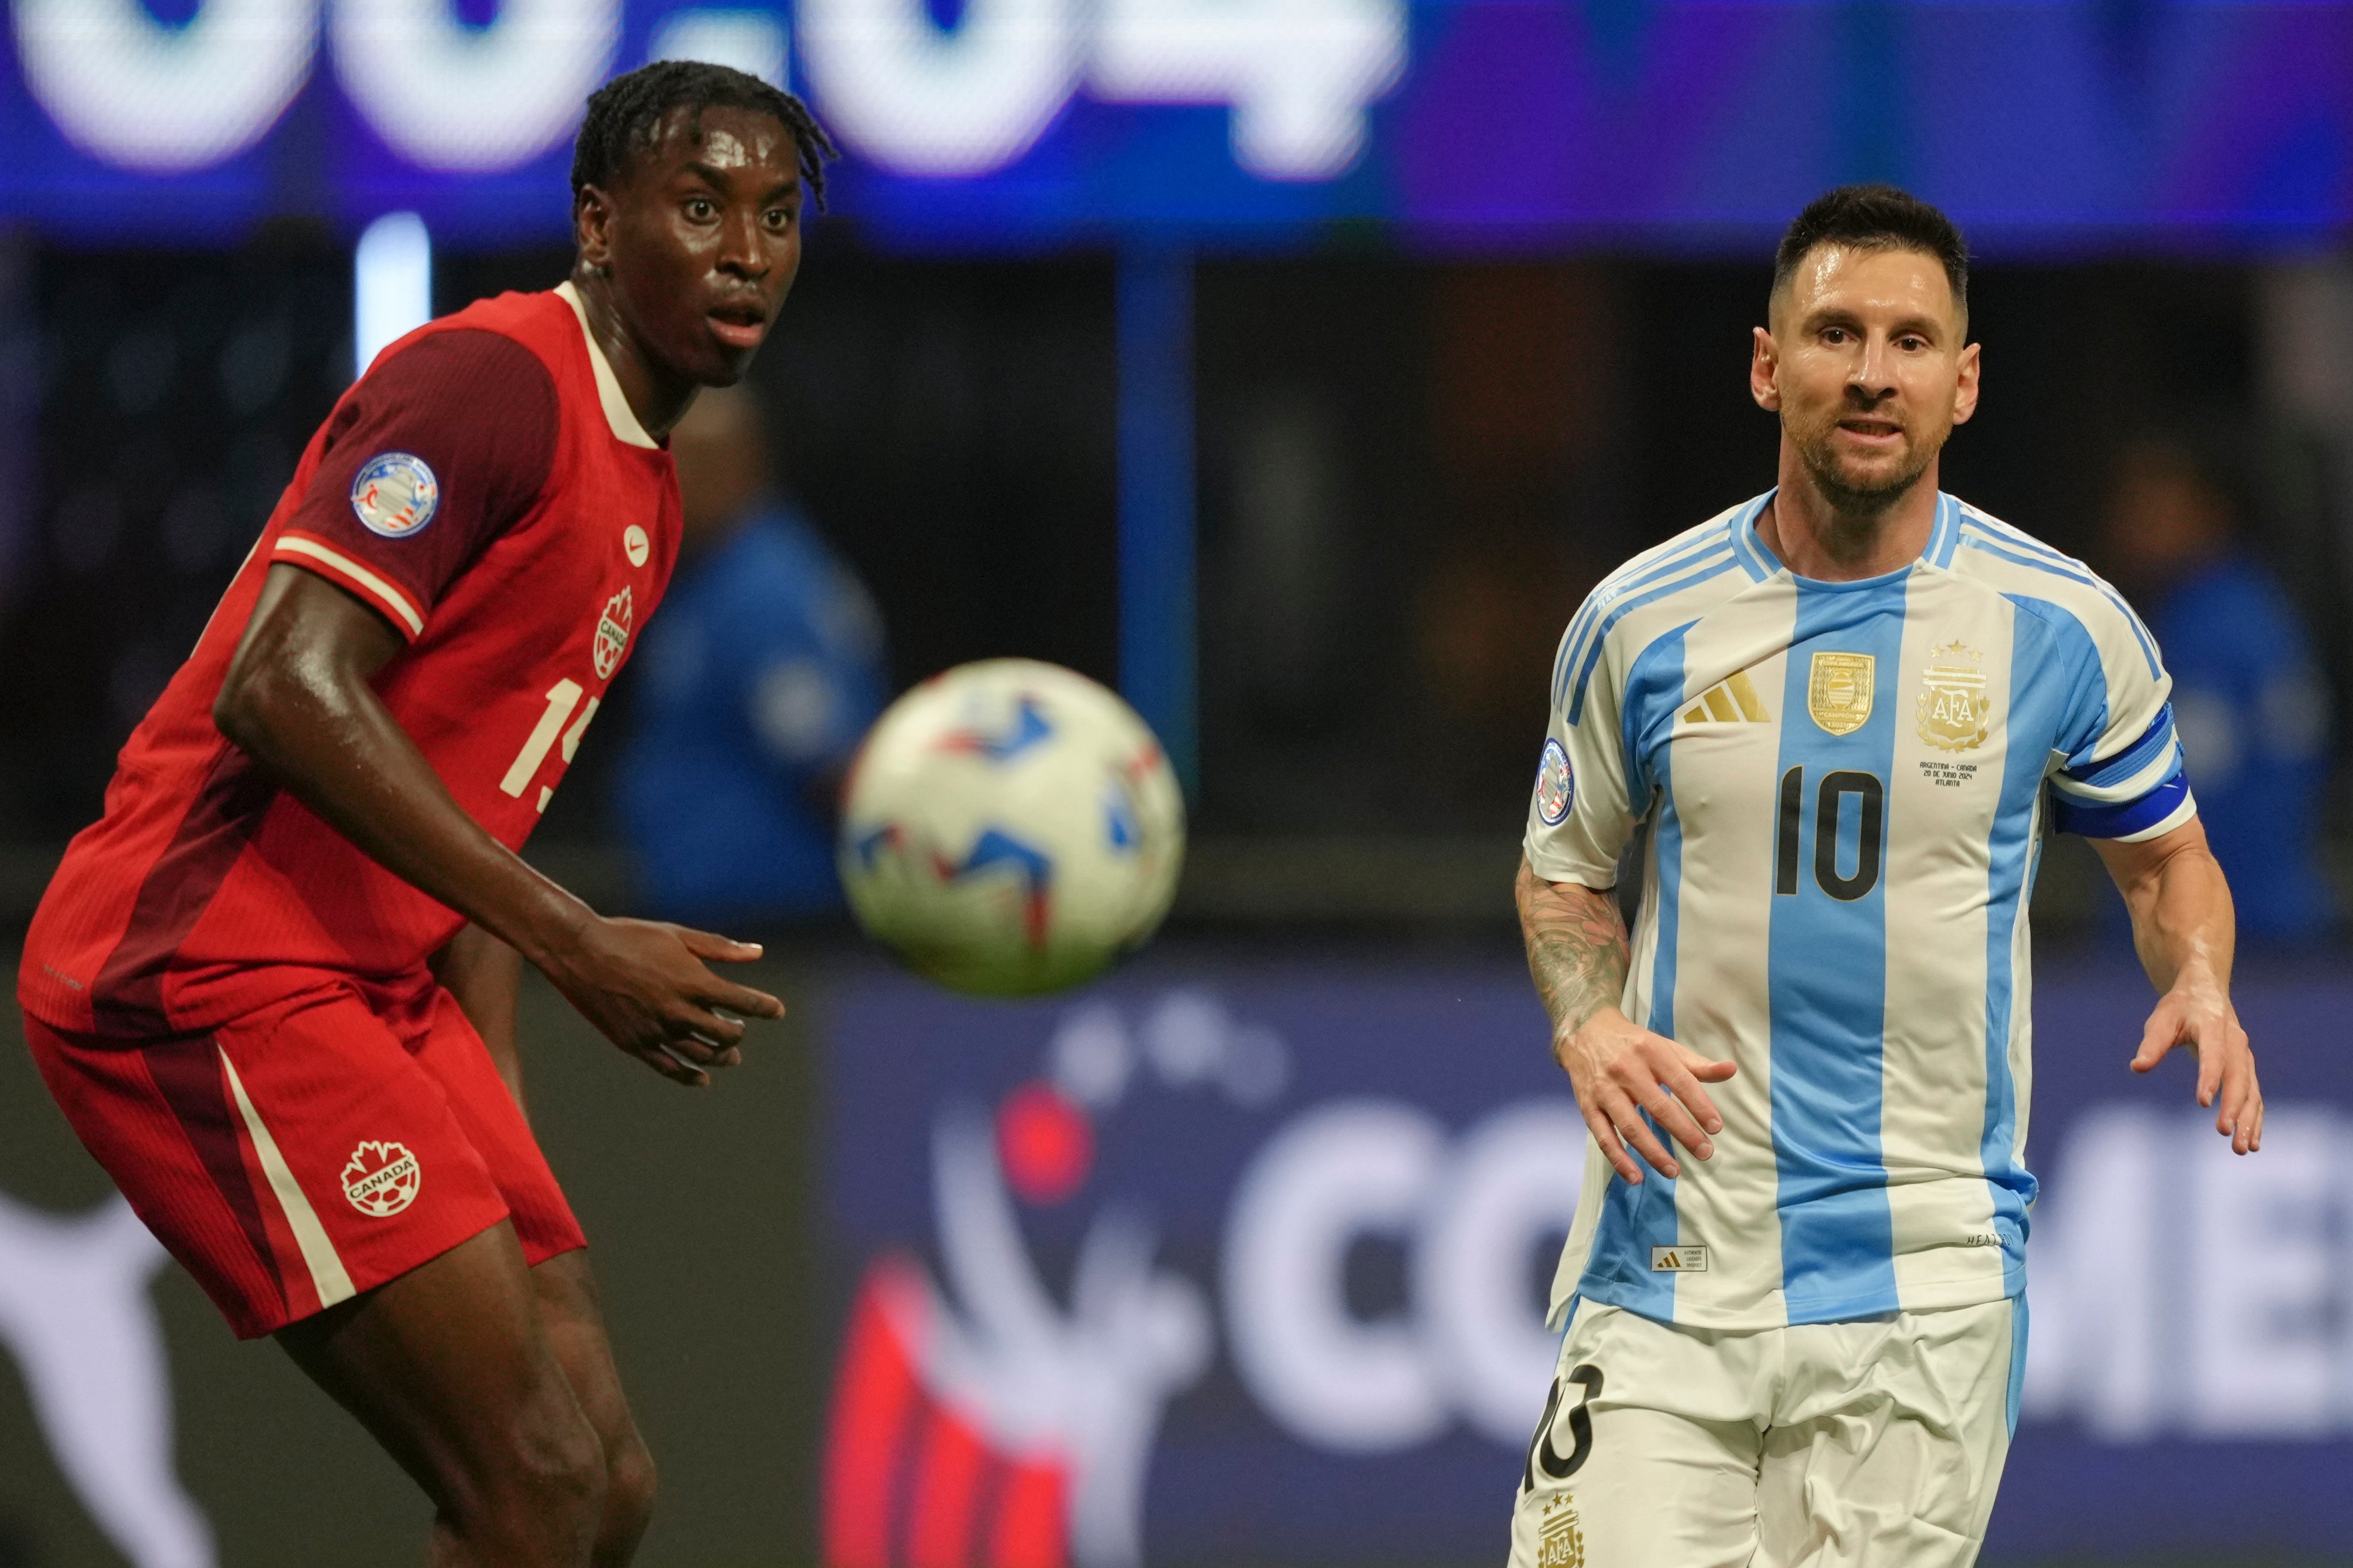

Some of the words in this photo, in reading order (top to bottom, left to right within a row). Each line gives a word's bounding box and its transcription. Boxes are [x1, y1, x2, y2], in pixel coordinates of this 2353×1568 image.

[1932, 687, 1974, 728] AFA
[1920, 762, 1949, 770] ARGENTINA
[1935, 779, 1960, 787] ATLANTA
[1776, 765, 1884, 902] 10
[350, 1159, 413, 1199] CANADA
[1547, 1530, 1574, 1566] AFA
